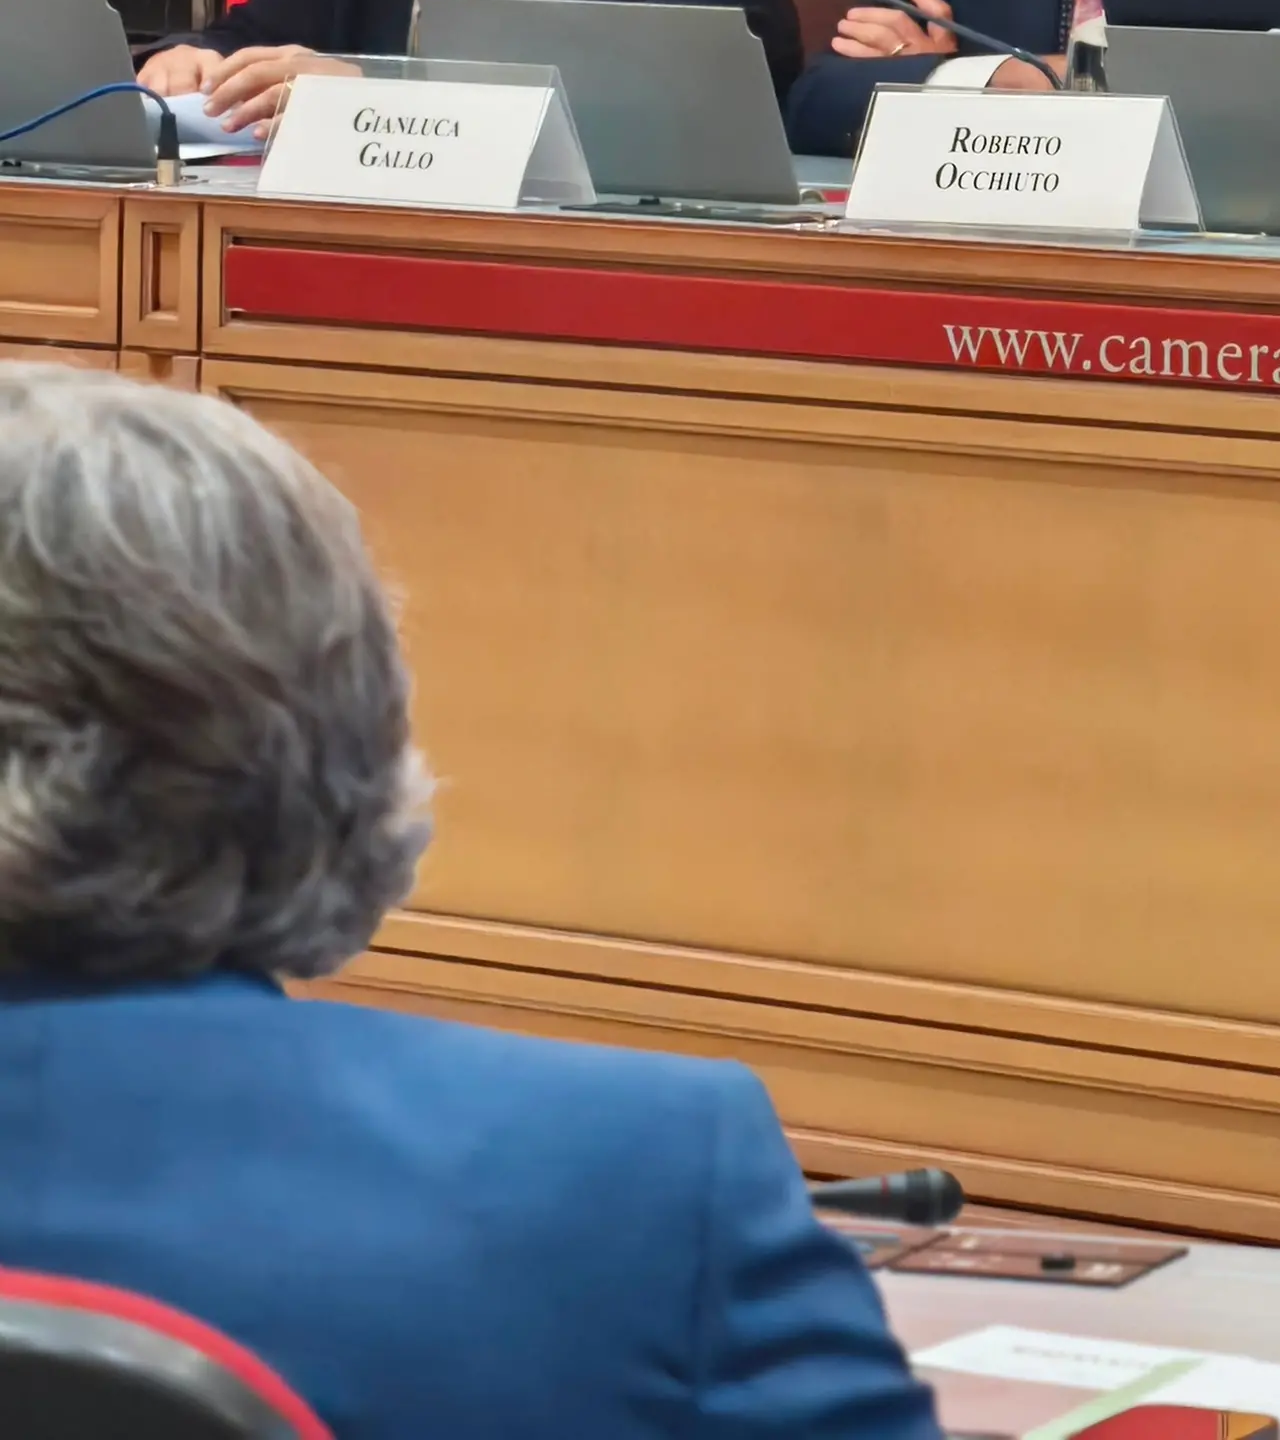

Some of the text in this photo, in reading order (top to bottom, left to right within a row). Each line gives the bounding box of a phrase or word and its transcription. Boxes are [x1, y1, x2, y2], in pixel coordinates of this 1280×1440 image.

[352, 107, 460, 137] GIANLUCA
[358, 142, 434, 170] GALLO
[950, 126, 1063, 156] ROBERTO
[934, 163, 1060, 193] OCCHIUTO
